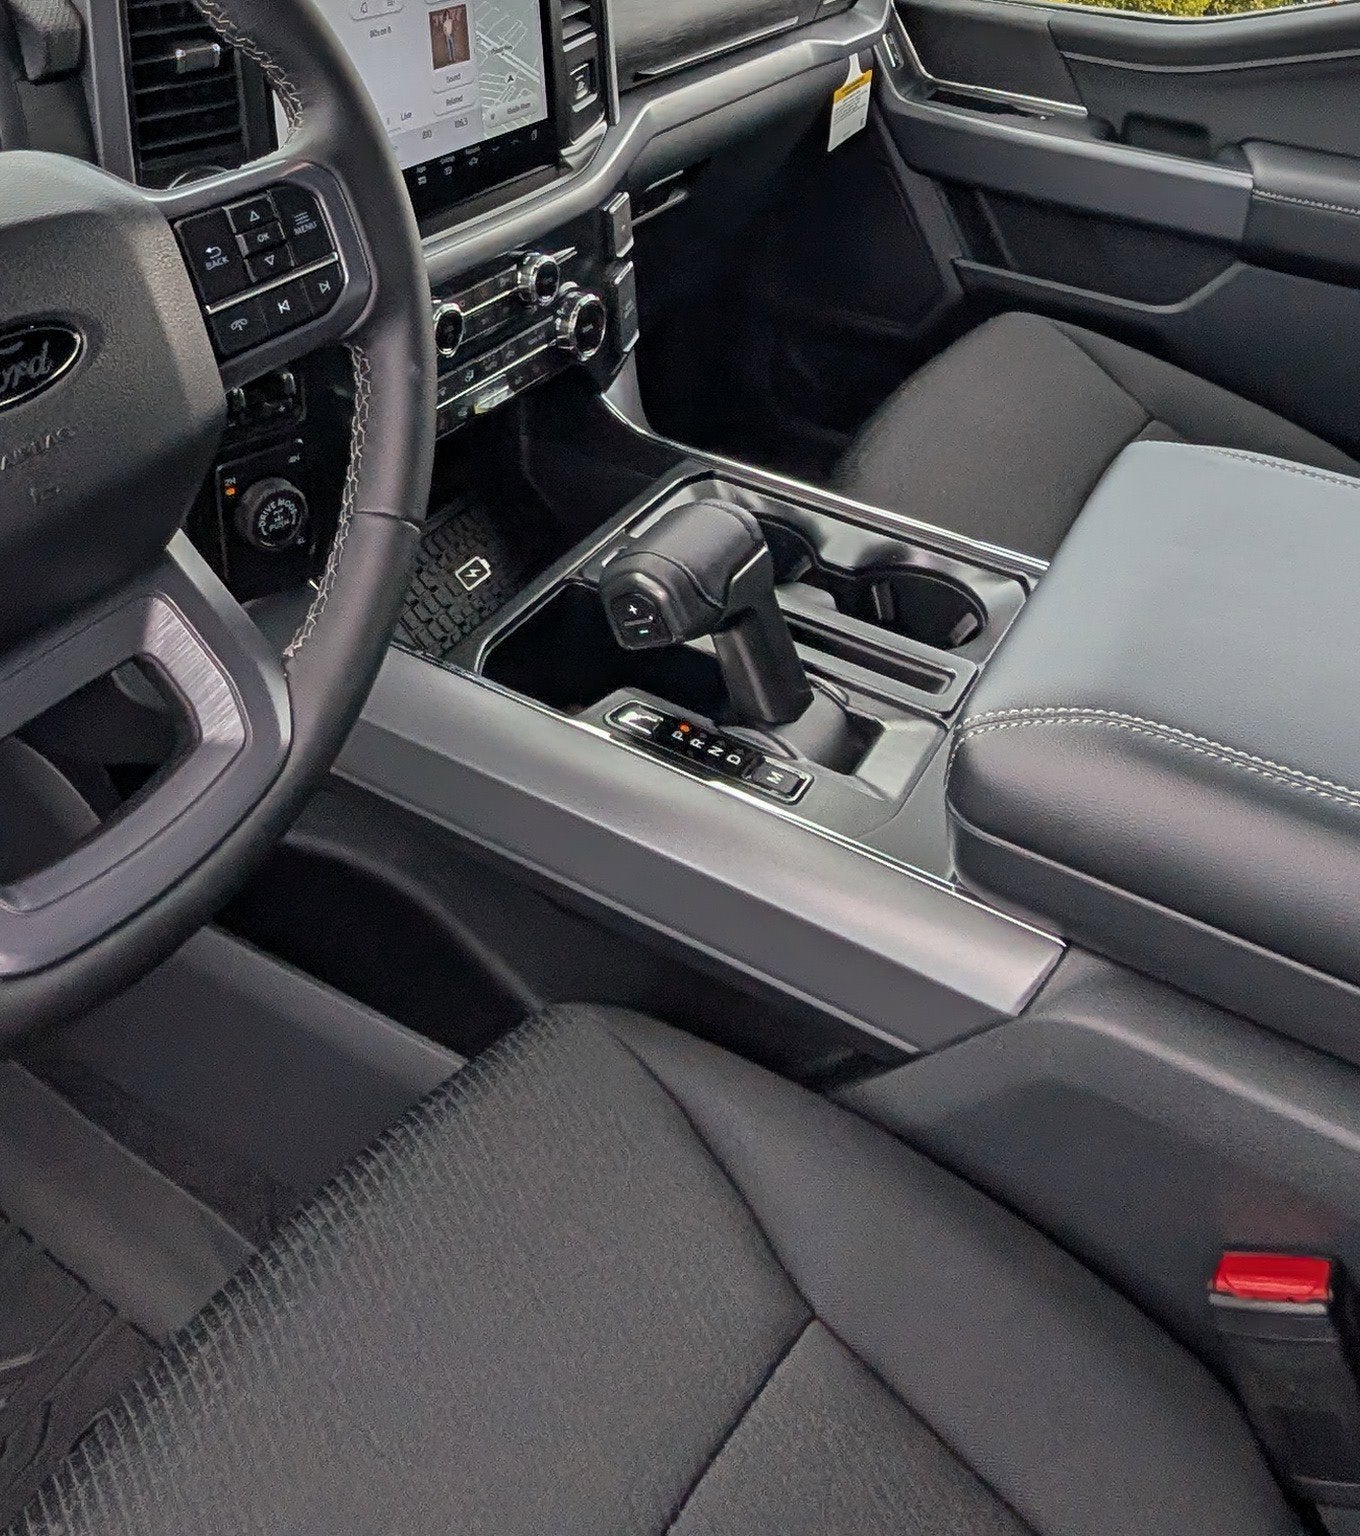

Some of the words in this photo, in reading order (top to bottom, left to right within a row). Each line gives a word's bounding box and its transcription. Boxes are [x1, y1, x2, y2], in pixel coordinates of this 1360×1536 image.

[293, 221, 317, 236] MENU
[256, 232, 270, 243] OK
[205, 255, 230, 271] BACK
[671, 730, 684, 742] P
[690, 738, 705, 750] R
[707, 745, 724, 758] N
[726, 753, 742, 766] D
